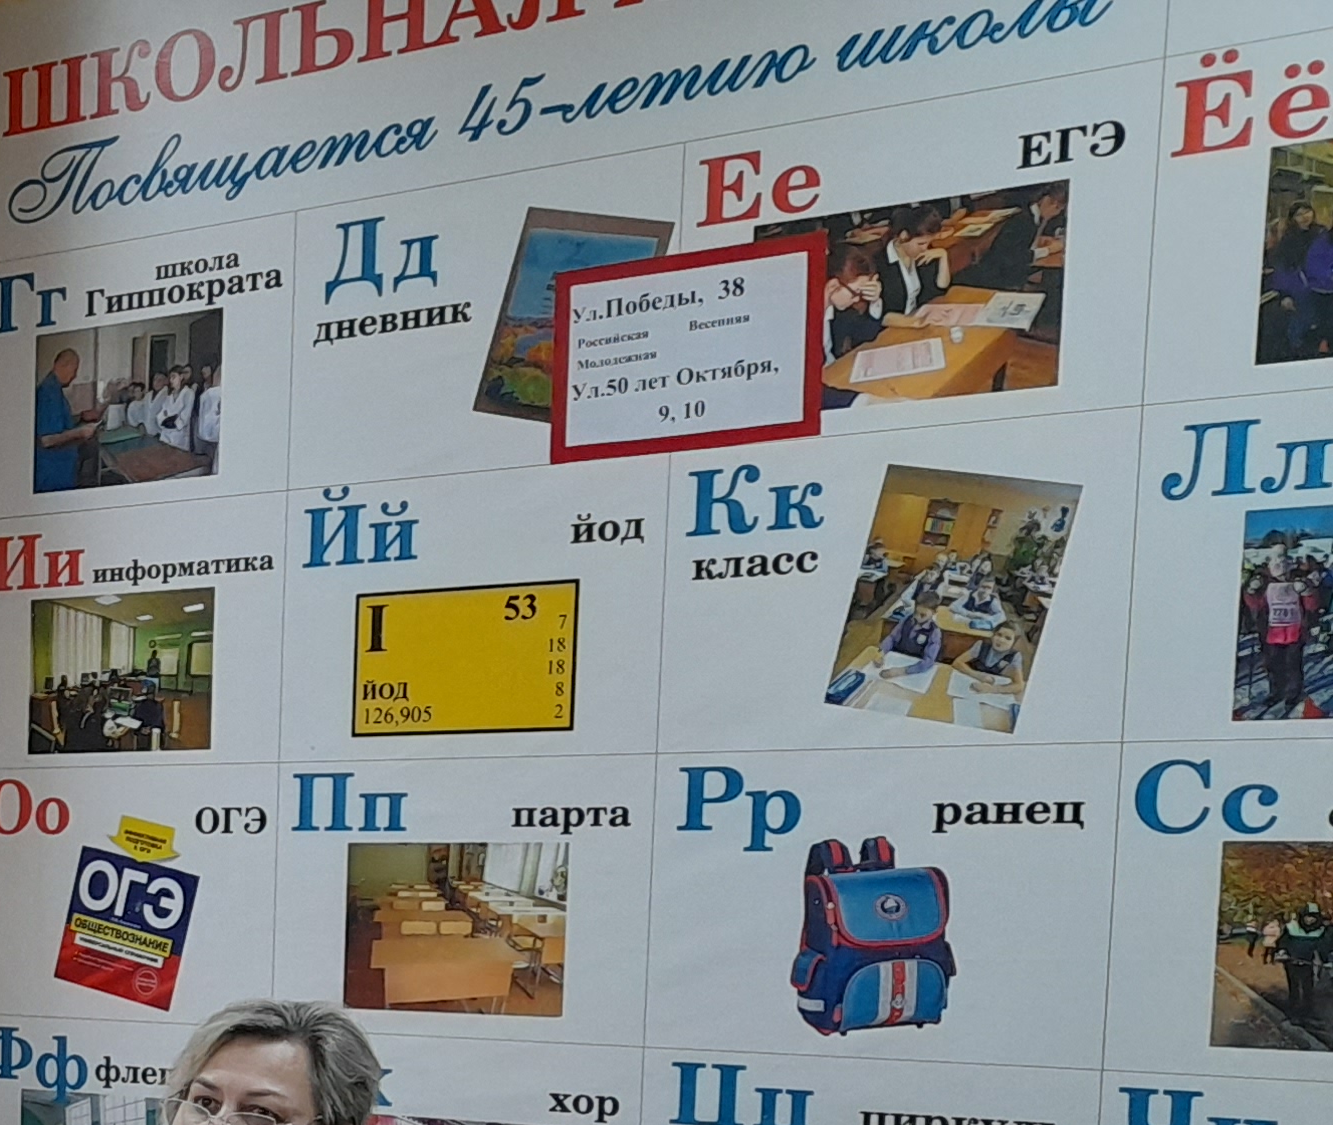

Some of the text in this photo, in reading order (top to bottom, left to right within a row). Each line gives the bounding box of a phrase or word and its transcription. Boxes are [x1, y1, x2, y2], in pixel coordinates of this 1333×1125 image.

[8, 0, 1114, 224] Посвящается 45-летию школы
[1171, 48, 1333, 159] Ёё
[1017, 120, 1126, 170] ЕГЭ
[696, 150, 821, 227] Ее
[155, 249, 239, 282] школа
[325, 216, 439, 304] Дд
[85, 267, 282, 317] Гиппократа
[573, 277, 745, 324] Ул.Победы, 38
[313, 299, 473, 347] дневник
[578, 314, 750, 349] Российская Весенняя
[577, 350, 657, 371] Молодежная
[572, 359, 779, 401] Ул.50 лет Октября,
[658, 400, 705, 423] 9, 10
[1161, 418, 1333, 500] Лл
[686, 463, 826, 538] Кк
[302, 485, 419, 569] Йй
[571, 514, 645, 545] йод
[93, 551, 274, 587] информатика
[692, 550, 819, 582] класс
[504, 594, 537, 620] 53
[559, 614, 567, 630] 7
[549, 637, 566, 653] 18
[548, 659, 565, 675] 18
[555, 682, 564, 697] 8
[364, 706, 432, 727] 126,905
[554, 704, 563, 719] 2
[291, 771, 631, 835] Пп парта
[676, 765, 1085, 852] Рр ранец
[1134, 759, 1278, 835] Сс
[195, 805, 268, 835] ОГЭ
[79, 859, 184, 930] ОГЭ
[74, 917, 169, 953] ОБЩЕСТВОЗНАНИЕ
[549, 1090, 620, 1124] хор
